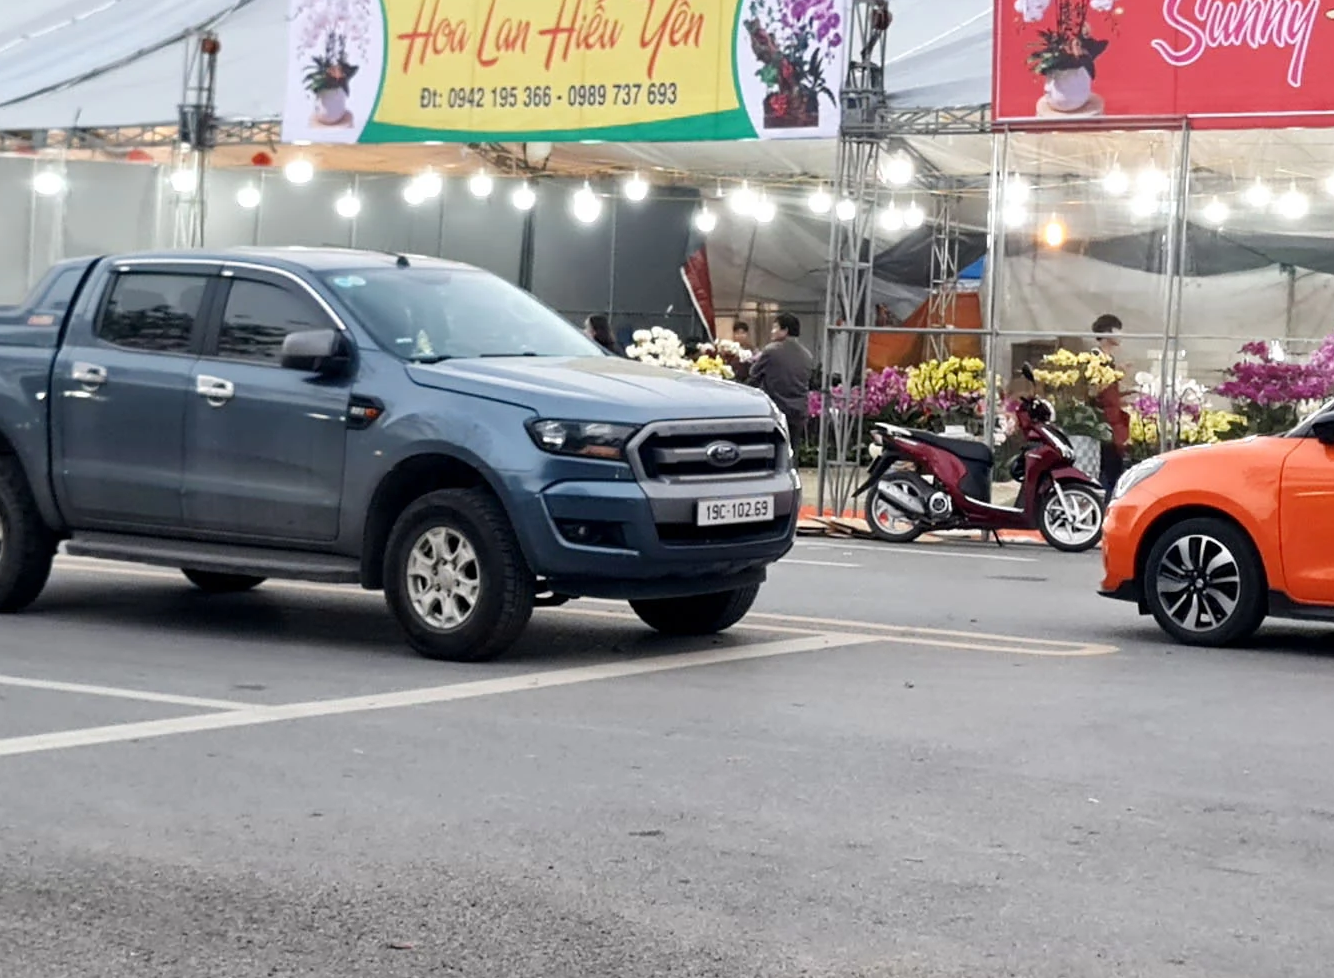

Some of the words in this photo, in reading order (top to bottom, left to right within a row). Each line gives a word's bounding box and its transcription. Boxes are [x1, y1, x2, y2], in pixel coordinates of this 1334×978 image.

[420, 87, 443, 109] Đt:
[448, 86, 485, 109] 0942
[491, 85, 518, 108] 195
[523, 85, 552, 108] 366
[567, 84, 607, 107] 0989
[612, 83, 643, 107] 737
[647, 82, 678, 106] 693
